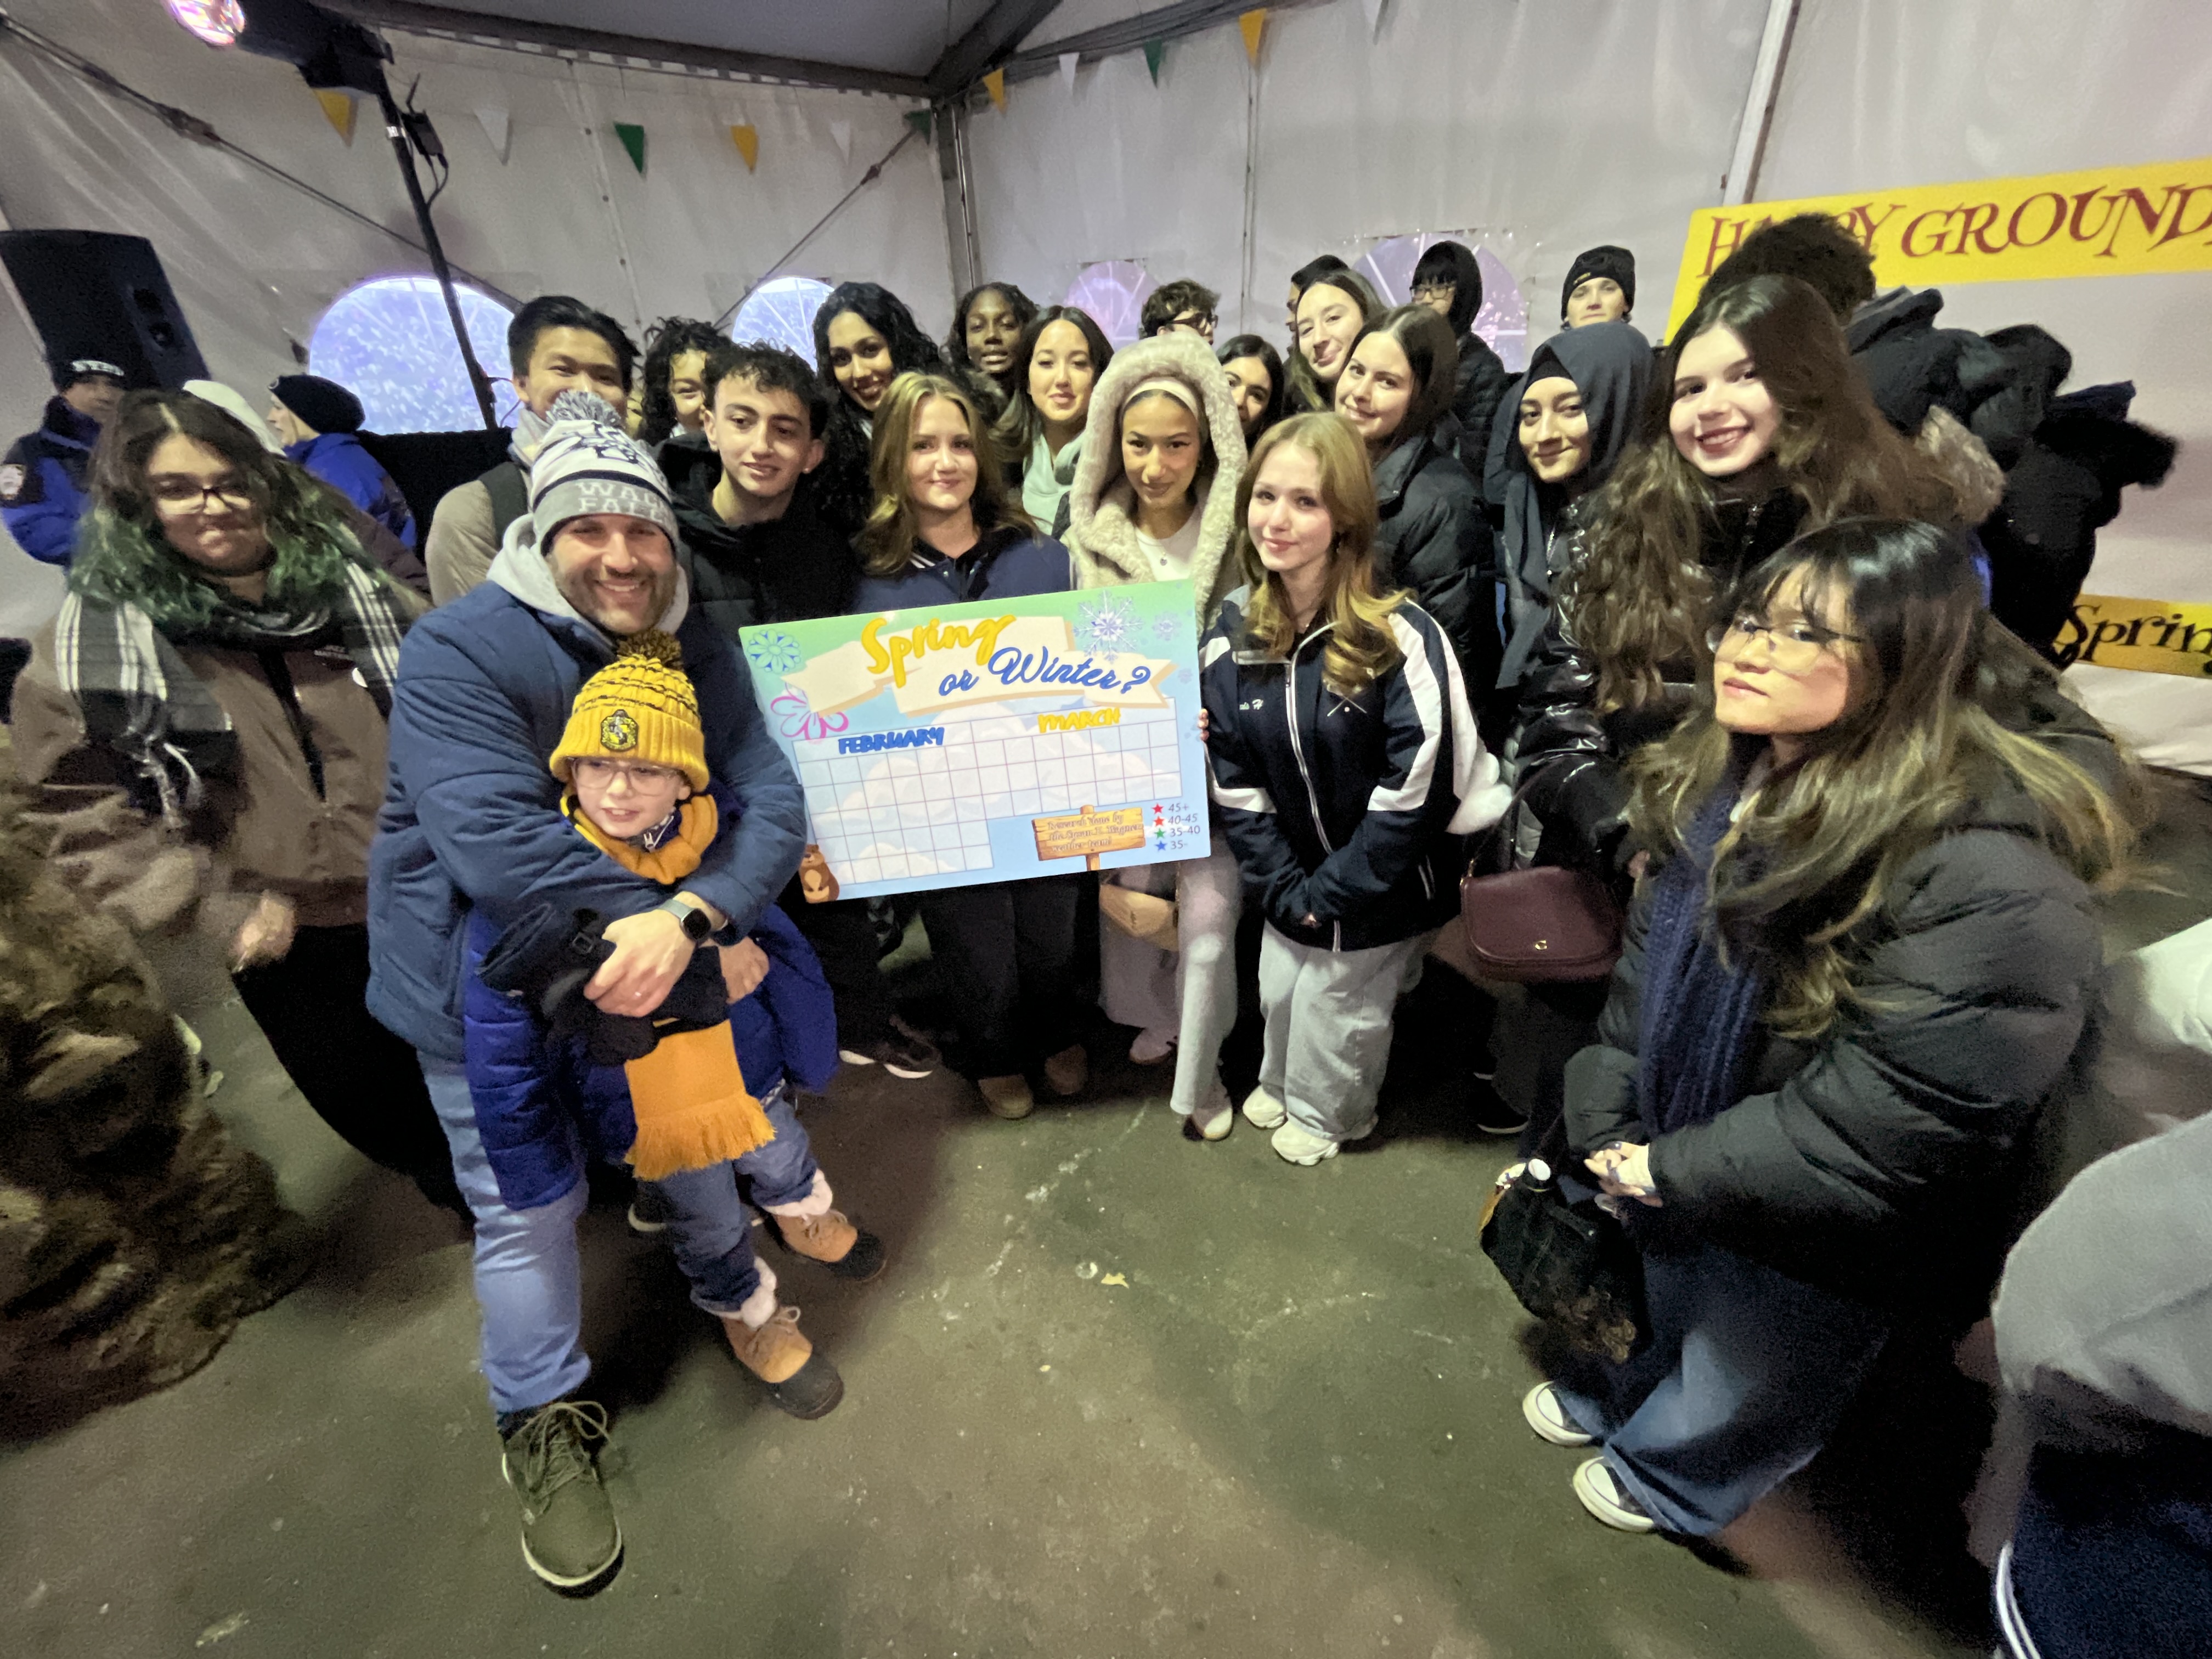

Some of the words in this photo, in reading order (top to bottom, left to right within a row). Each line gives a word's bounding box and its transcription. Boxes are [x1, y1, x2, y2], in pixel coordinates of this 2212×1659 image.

[1900, 183, 2212, 258] GROUND
[861, 614, 1017, 689] Spring
[2053, 605, 2212, 674] Sprin
[939, 669, 979, 696] or
[988, 646, 1151, 694] Winter?
[1037, 707, 1121, 733] MARCH
[838, 727, 945, 754] FEBRUARY
[1113, 811, 1124, 826] by
[1167, 813, 1198, 825] 40-45
[1168, 803, 1189, 812] 45+
[1170, 825, 1200, 837] 35-40
[1170, 839, 1188, 850] 35-
